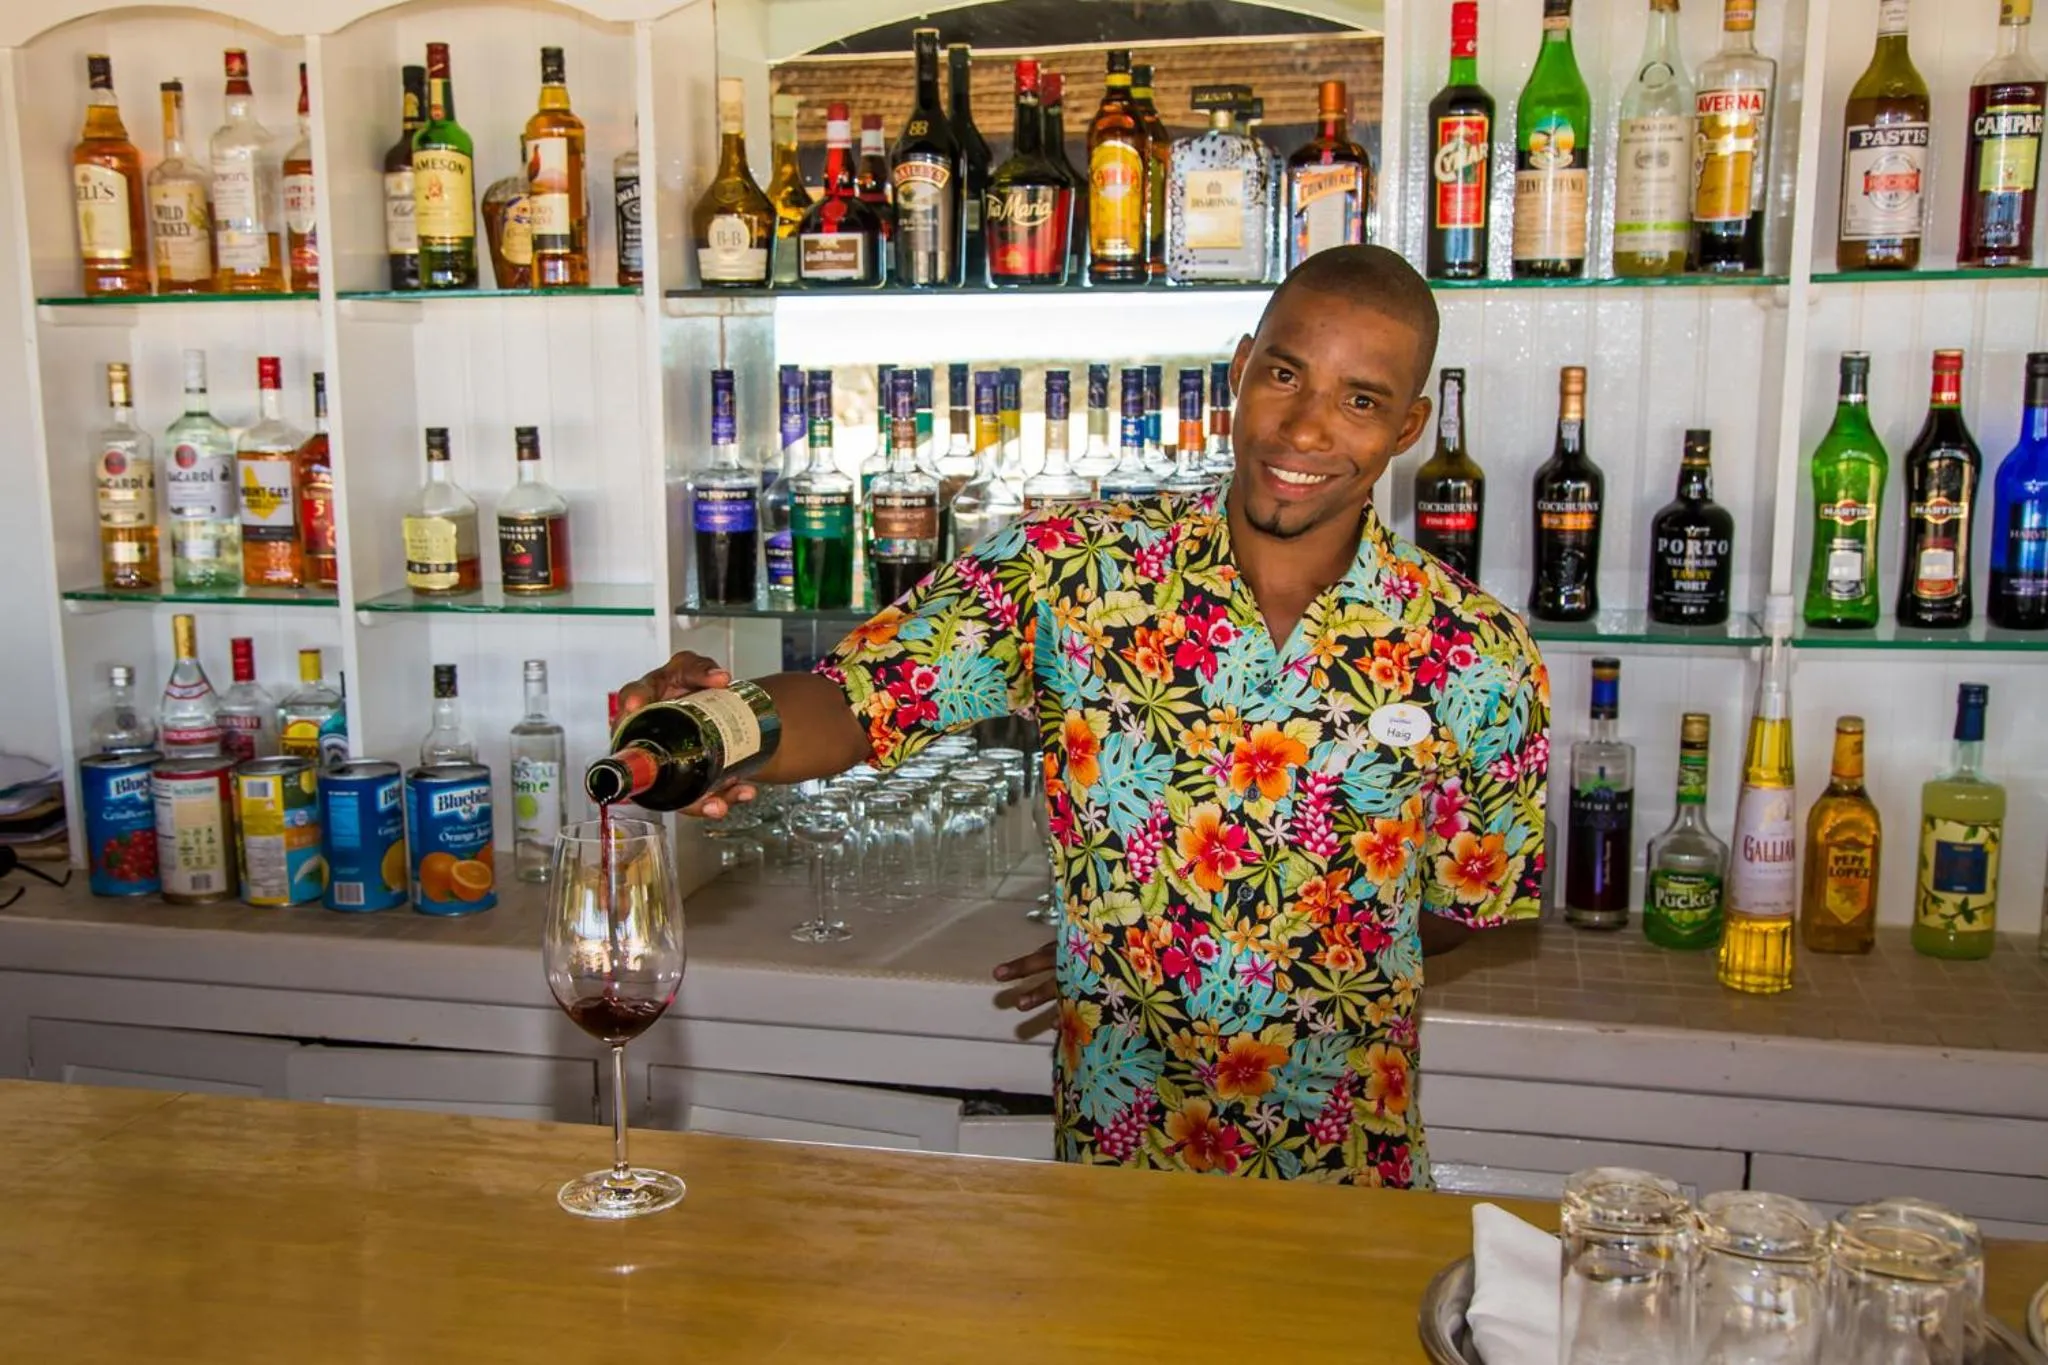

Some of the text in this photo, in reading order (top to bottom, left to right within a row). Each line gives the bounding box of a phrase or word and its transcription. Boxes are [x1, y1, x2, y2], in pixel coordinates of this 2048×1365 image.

[1697, 93, 1762, 113] AVERNA
[1974, 114, 2044, 136] CAMPAR
[1859, 129, 1928, 147] PASTIS
[415, 157, 466, 176] AMESON
[76, 182, 116, 200] ELL'S
[154, 204, 184, 221] WILD
[986, 193, 1053, 221] Tia Maria
[1657, 538, 1730, 556] PORTO
[1674, 581, 1709, 592] PORT
[1386, 727, 1412, 741] Haig
[1828, 866, 1871, 880] LOPEZ
[1655, 887, 1720, 909] Pucker
